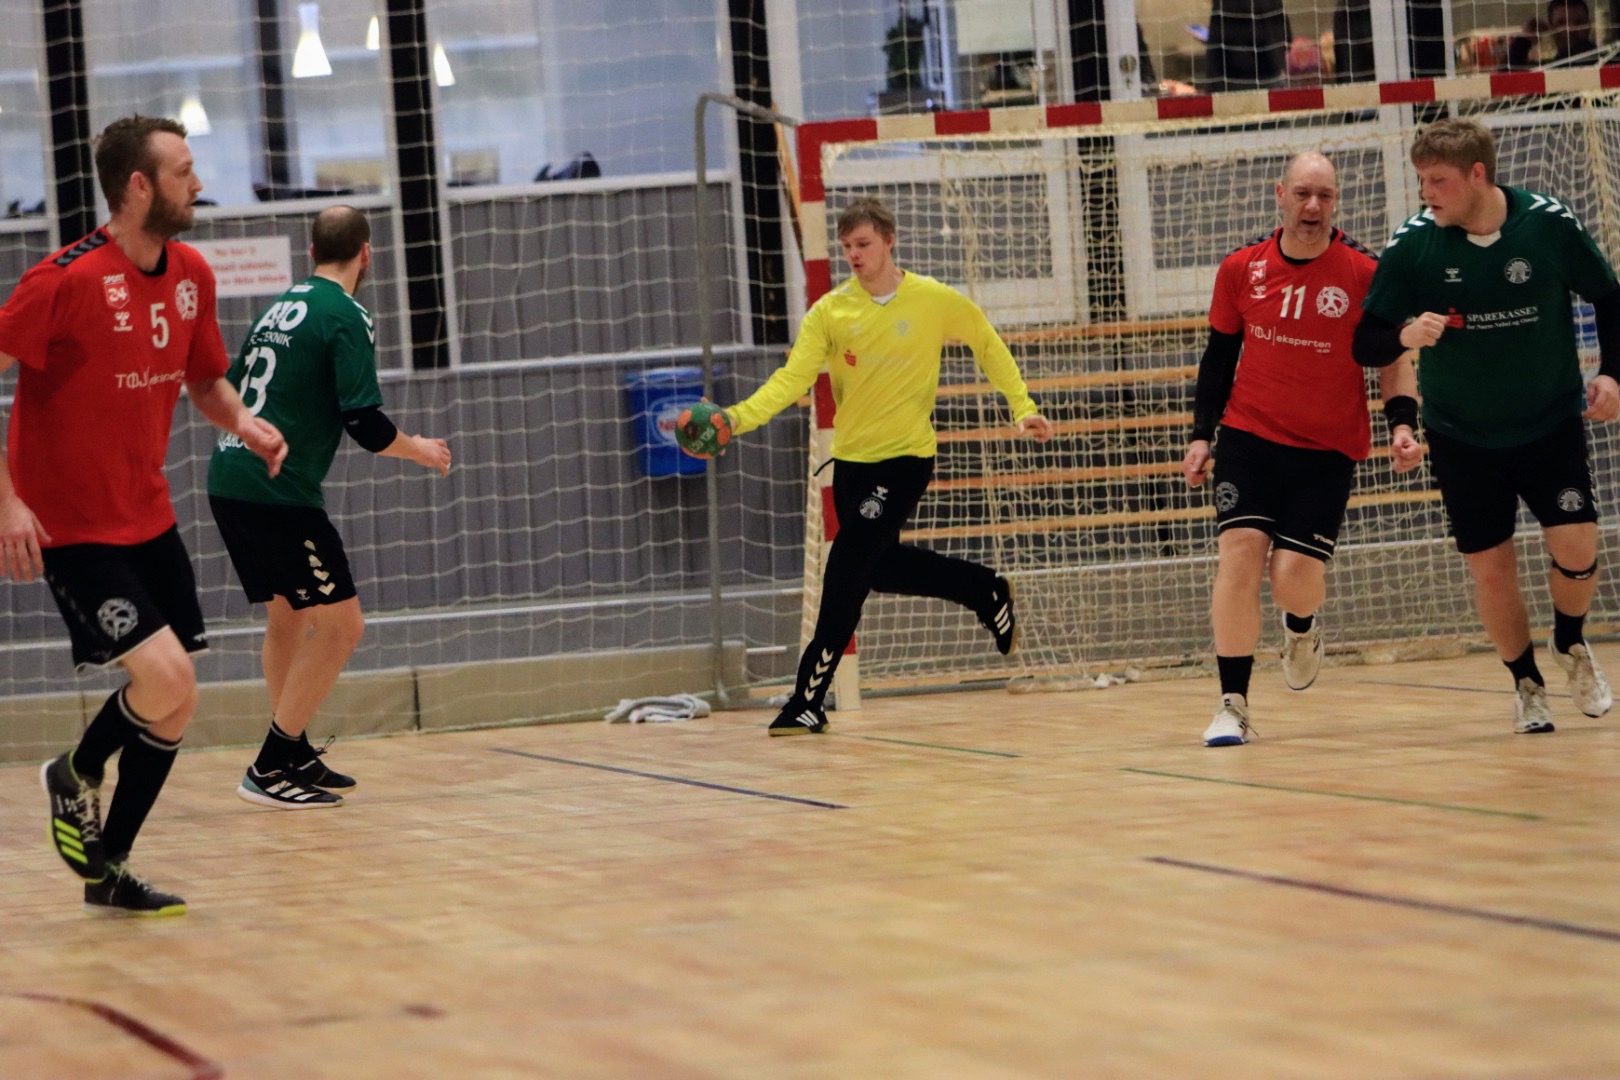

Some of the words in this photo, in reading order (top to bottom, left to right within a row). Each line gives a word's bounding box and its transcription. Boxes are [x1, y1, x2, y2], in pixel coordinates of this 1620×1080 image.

[107, 287, 127, 302] 24
[1279, 284, 1307, 320] 11
[149, 302, 170, 349] 5
[1466, 306, 1538, 322] SPAREKASSEN
[1276, 334, 1332, 349] eksperten
[240, 346, 277, 416] 13
